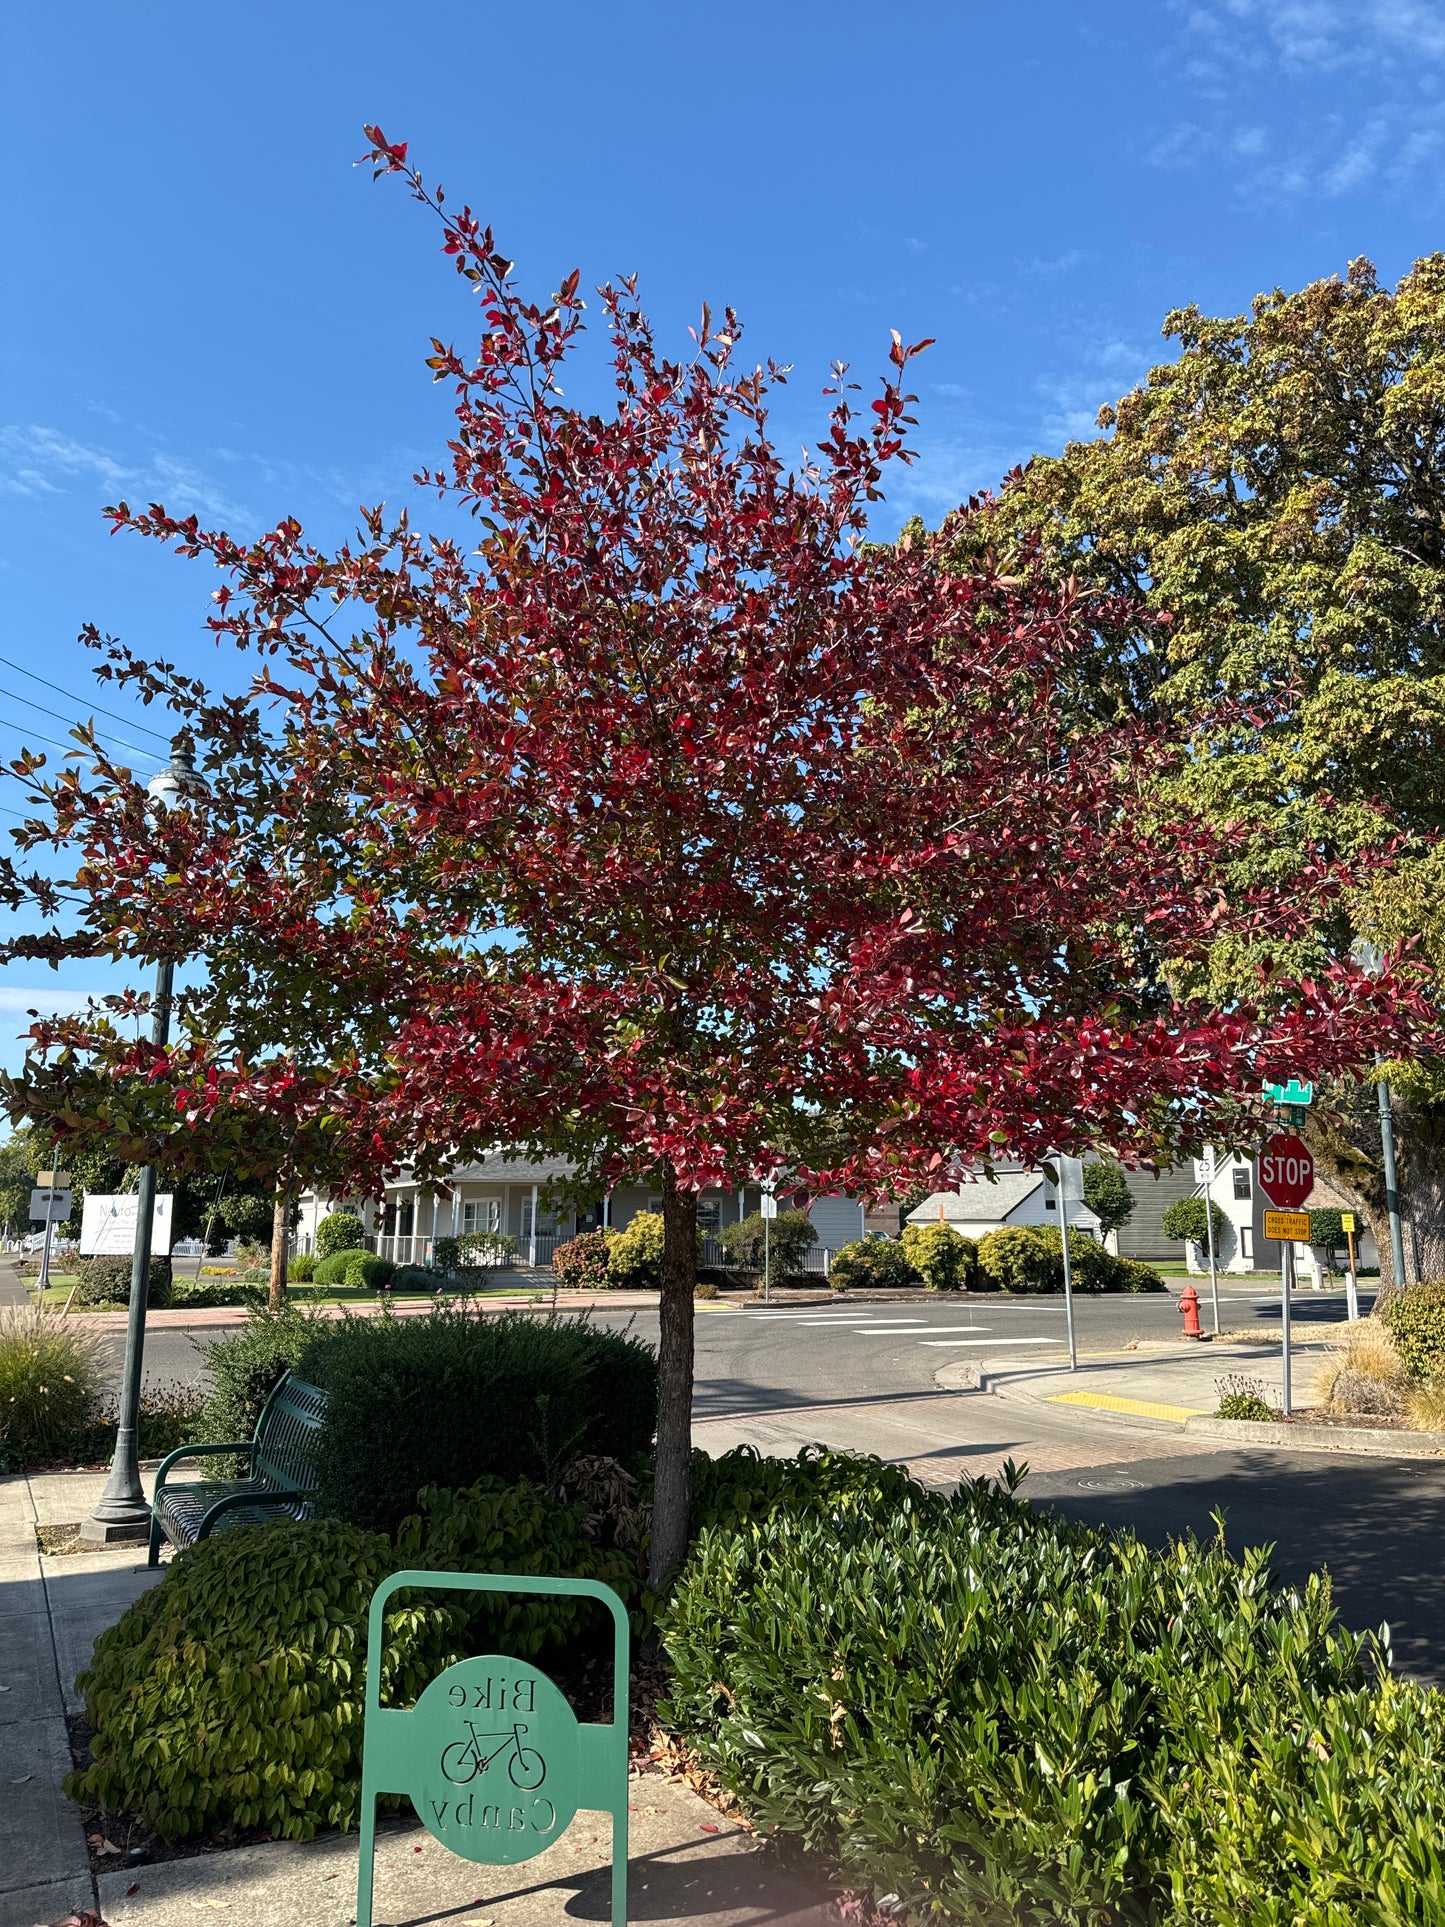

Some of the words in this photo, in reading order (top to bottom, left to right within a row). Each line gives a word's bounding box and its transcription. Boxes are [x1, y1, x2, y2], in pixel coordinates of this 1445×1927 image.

[1199, 1158, 1210, 1171] 25
[1263, 1156, 1310, 1186] STOP
[1268, 1216, 1284, 1225] CROSS
[1286, 1217, 1307, 1226] TRAFFIC
[1268, 1226, 1281, 1234] DOES
[1295, 1228, 1307, 1236] STOP
